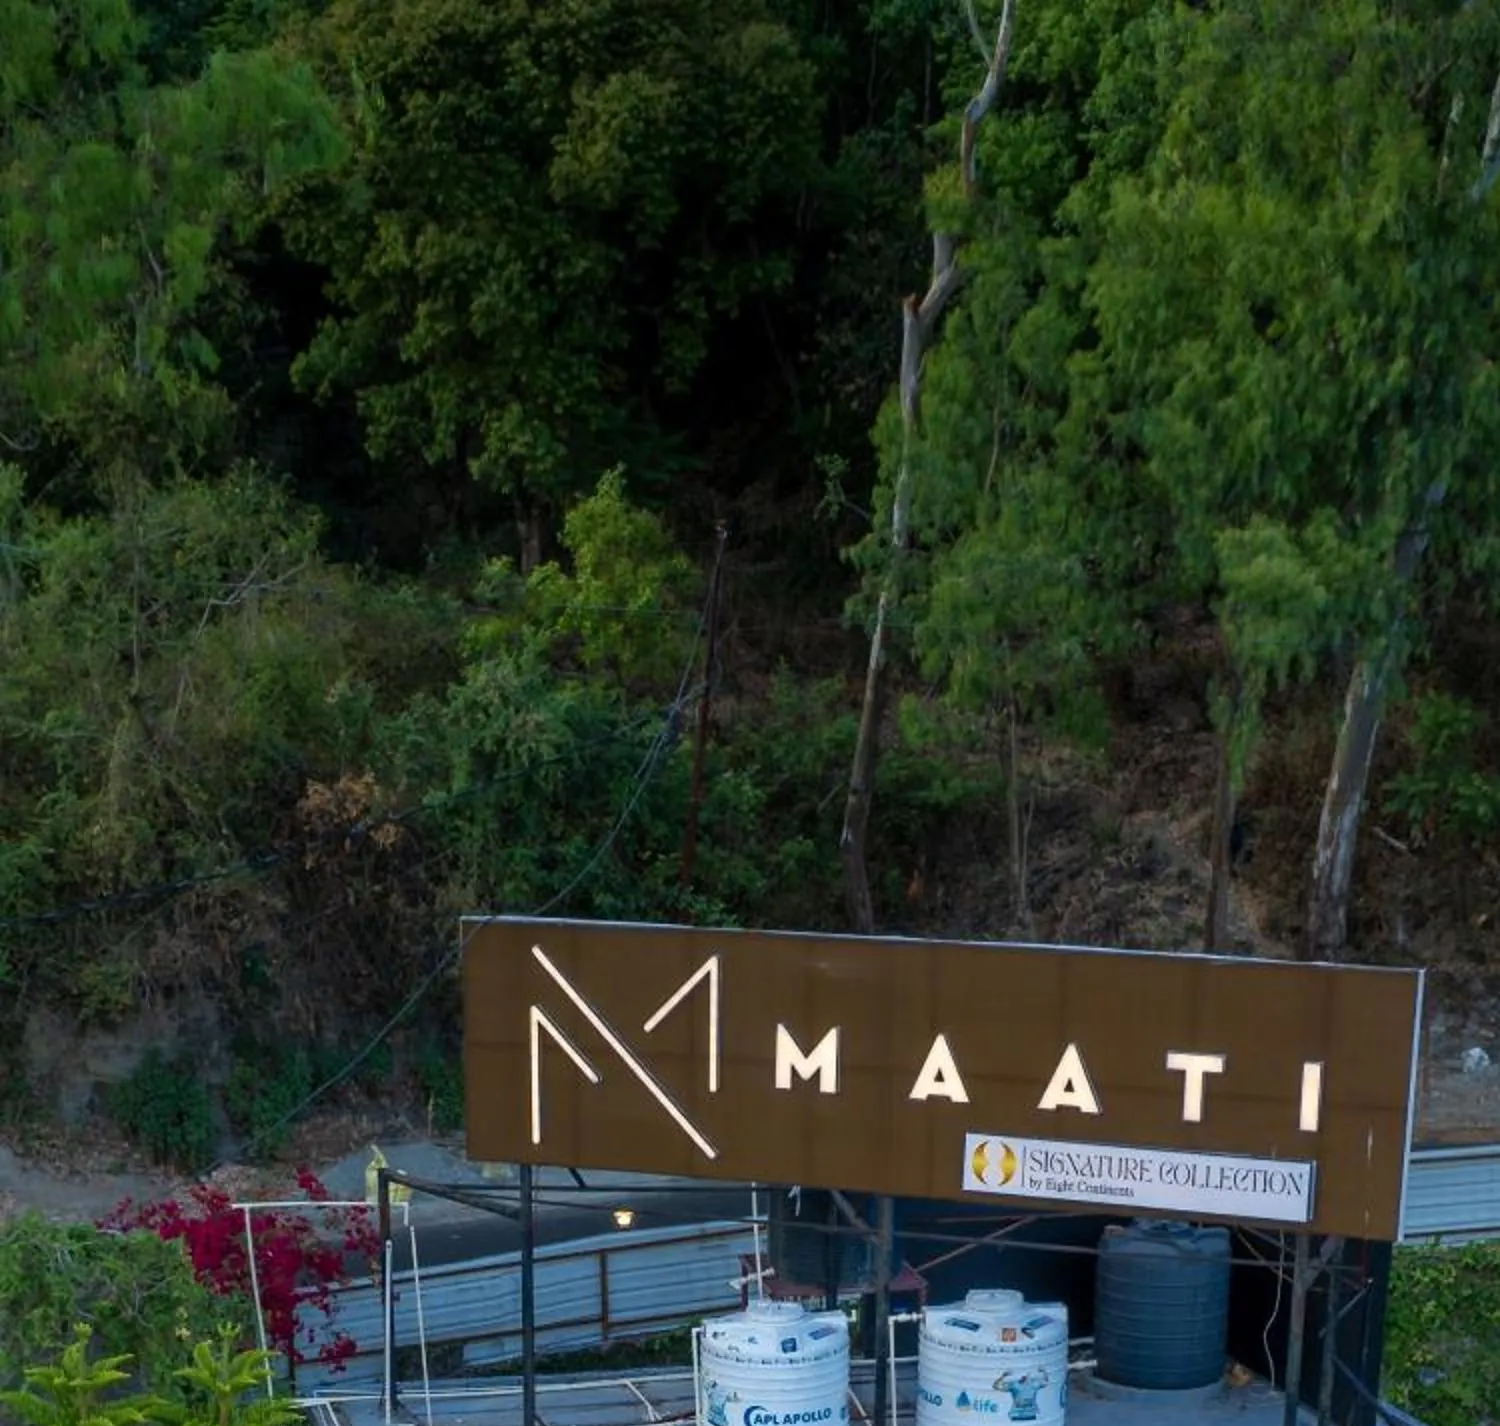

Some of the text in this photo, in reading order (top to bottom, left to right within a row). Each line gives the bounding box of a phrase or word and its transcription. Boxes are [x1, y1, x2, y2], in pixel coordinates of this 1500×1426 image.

[775, 1023, 1324, 1131] MAATI
[1029, 1149, 1304, 1197] SIGNATURE COLLECTION
[1029, 1177, 1042, 1191] by
[1045, 1177, 1075, 1193] Eight
[754, 1407, 832, 1425] APL APOLLO
